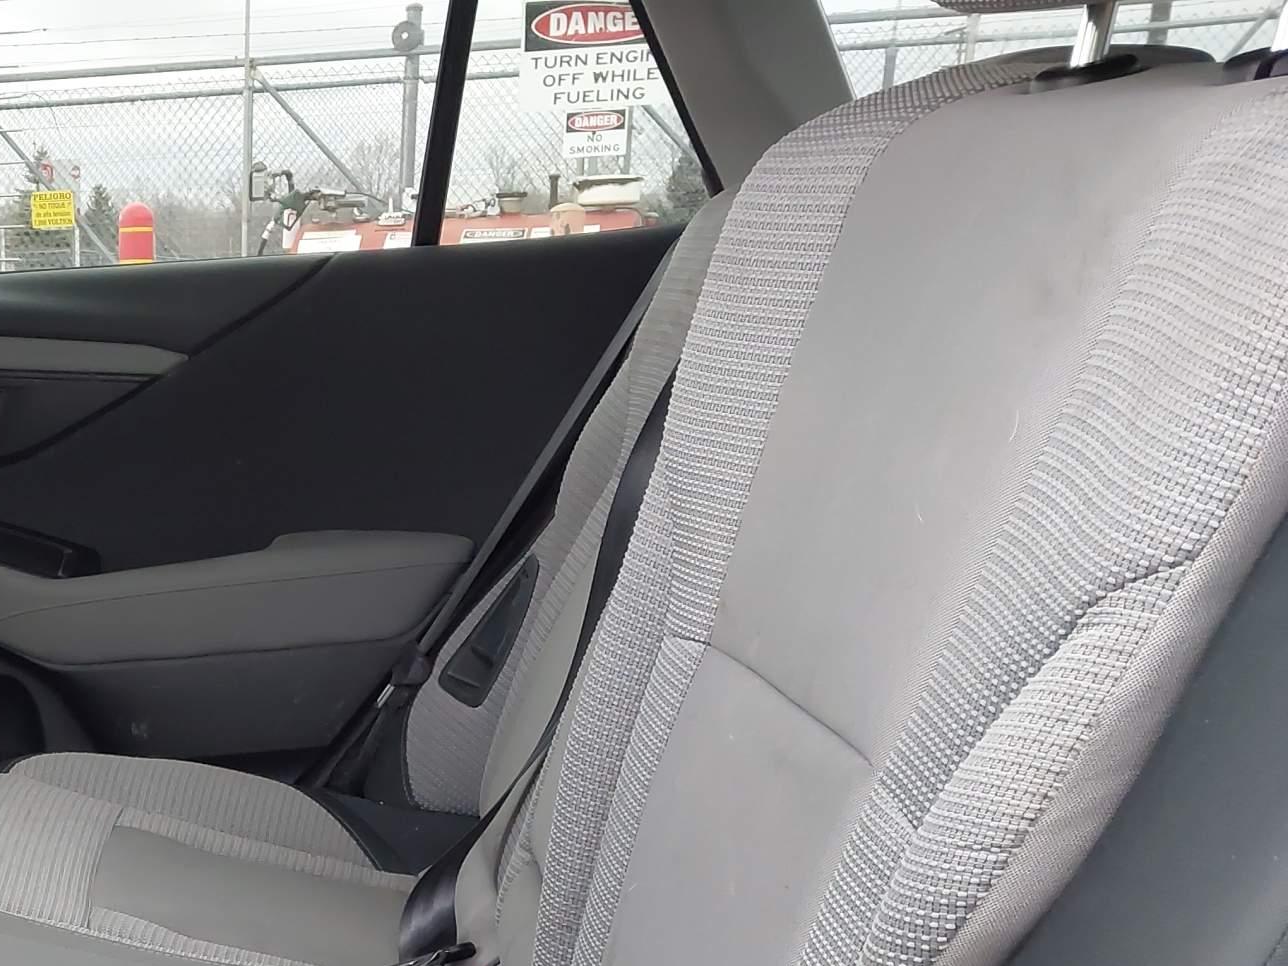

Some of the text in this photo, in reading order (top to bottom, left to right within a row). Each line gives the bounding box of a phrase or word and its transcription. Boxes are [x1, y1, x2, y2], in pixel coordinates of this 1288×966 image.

[549, 11, 640, 37] DANGE
[531, 49, 653, 70] TURN ENGI
[543, 67, 659, 88] OFF WHILE
[553, 86, 646, 105] FUELING
[575, 114, 618, 128] DANGER
[587, 134, 602, 142] NO
[569, 144, 620, 154] SMOKING
